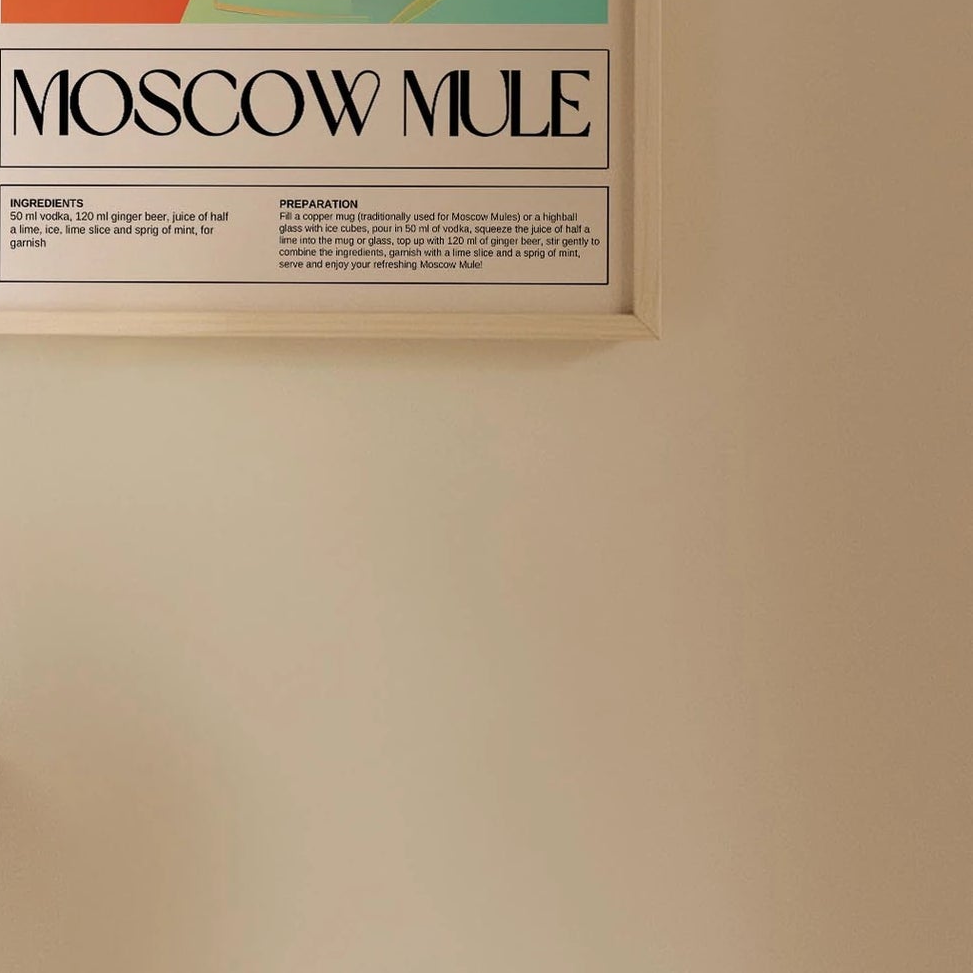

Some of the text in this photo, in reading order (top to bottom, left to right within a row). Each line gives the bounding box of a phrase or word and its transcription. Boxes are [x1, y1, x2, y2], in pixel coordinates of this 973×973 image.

[13, 69, 592, 138] MOSCOW MULE
[10, 198, 83, 208] INGREDIENTS
[280, 199, 358, 209] PREPARATION
[10, 211, 228, 224] 50 ml vodka, 120 ml ginger beer, juice of half
[279, 212, 292, 220] Fill
[302, 214, 333, 223] copper
[335, 214, 356, 223] mug
[357, 212, 412, 224] (traditionally
[413, 213, 436, 221] used
[437, 213, 450, 221] for
[451, 213, 489, 221] Moscow
[490, 213, 521, 223] Mules)
[542, 213, 578, 224] highball
[10, 224, 214, 238] a lime, ice, lime slice and sprig of mint, for
[279, 224, 303, 235] glass
[305, 224, 323, 232] with
[325, 224, 338, 232] ice
[341, 224, 369, 235] cubes,
[372, 226, 392, 235] pour
[395, 224, 402, 232] in
[405, 224, 416, 233] 50
[419, 224, 429, 233] ml
[432, 224, 440, 233] of
[443, 224, 472, 235] vodka,
[475, 226, 512, 236] squeeze
[515, 225, 529, 233] the
[531, 225, 551, 236] juice
[555, 225, 563, 235] of
[566, 225, 581, 233] half
[10, 238, 46, 251] garnish
[279, 236, 297, 244] lime
[319, 236, 332, 245] the
[335, 238, 354, 247] mug
[368, 236, 394, 247] glass,
[397, 238, 411, 247] top
[414, 238, 424, 247] up
[427, 236, 444, 245] with
[448, 236, 464, 245] 120
[467, 237, 477, 245] ml
[479, 236, 488, 245] of
[491, 236, 518, 247] ginger
[521, 237, 543, 247] beer,
[546, 237, 560, 245] stir
[562, 237, 589, 247] gently
[279, 247, 317, 256] combine
[319, 247, 333, 256] the
[336, 247, 386, 259] ingredients,
[389, 248, 421, 259] garnish
[424, 248, 442, 257] with
[453, 248, 471, 257] lime
[474, 248, 493, 257] slice
[496, 247, 513, 257] and
[524, 248, 545, 259] sprig
[548, 248, 556, 257] of
[559, 247, 580, 259] mint,
[278, 259, 482, 271] serve and enjoy your refreshing Moscow Mule!
